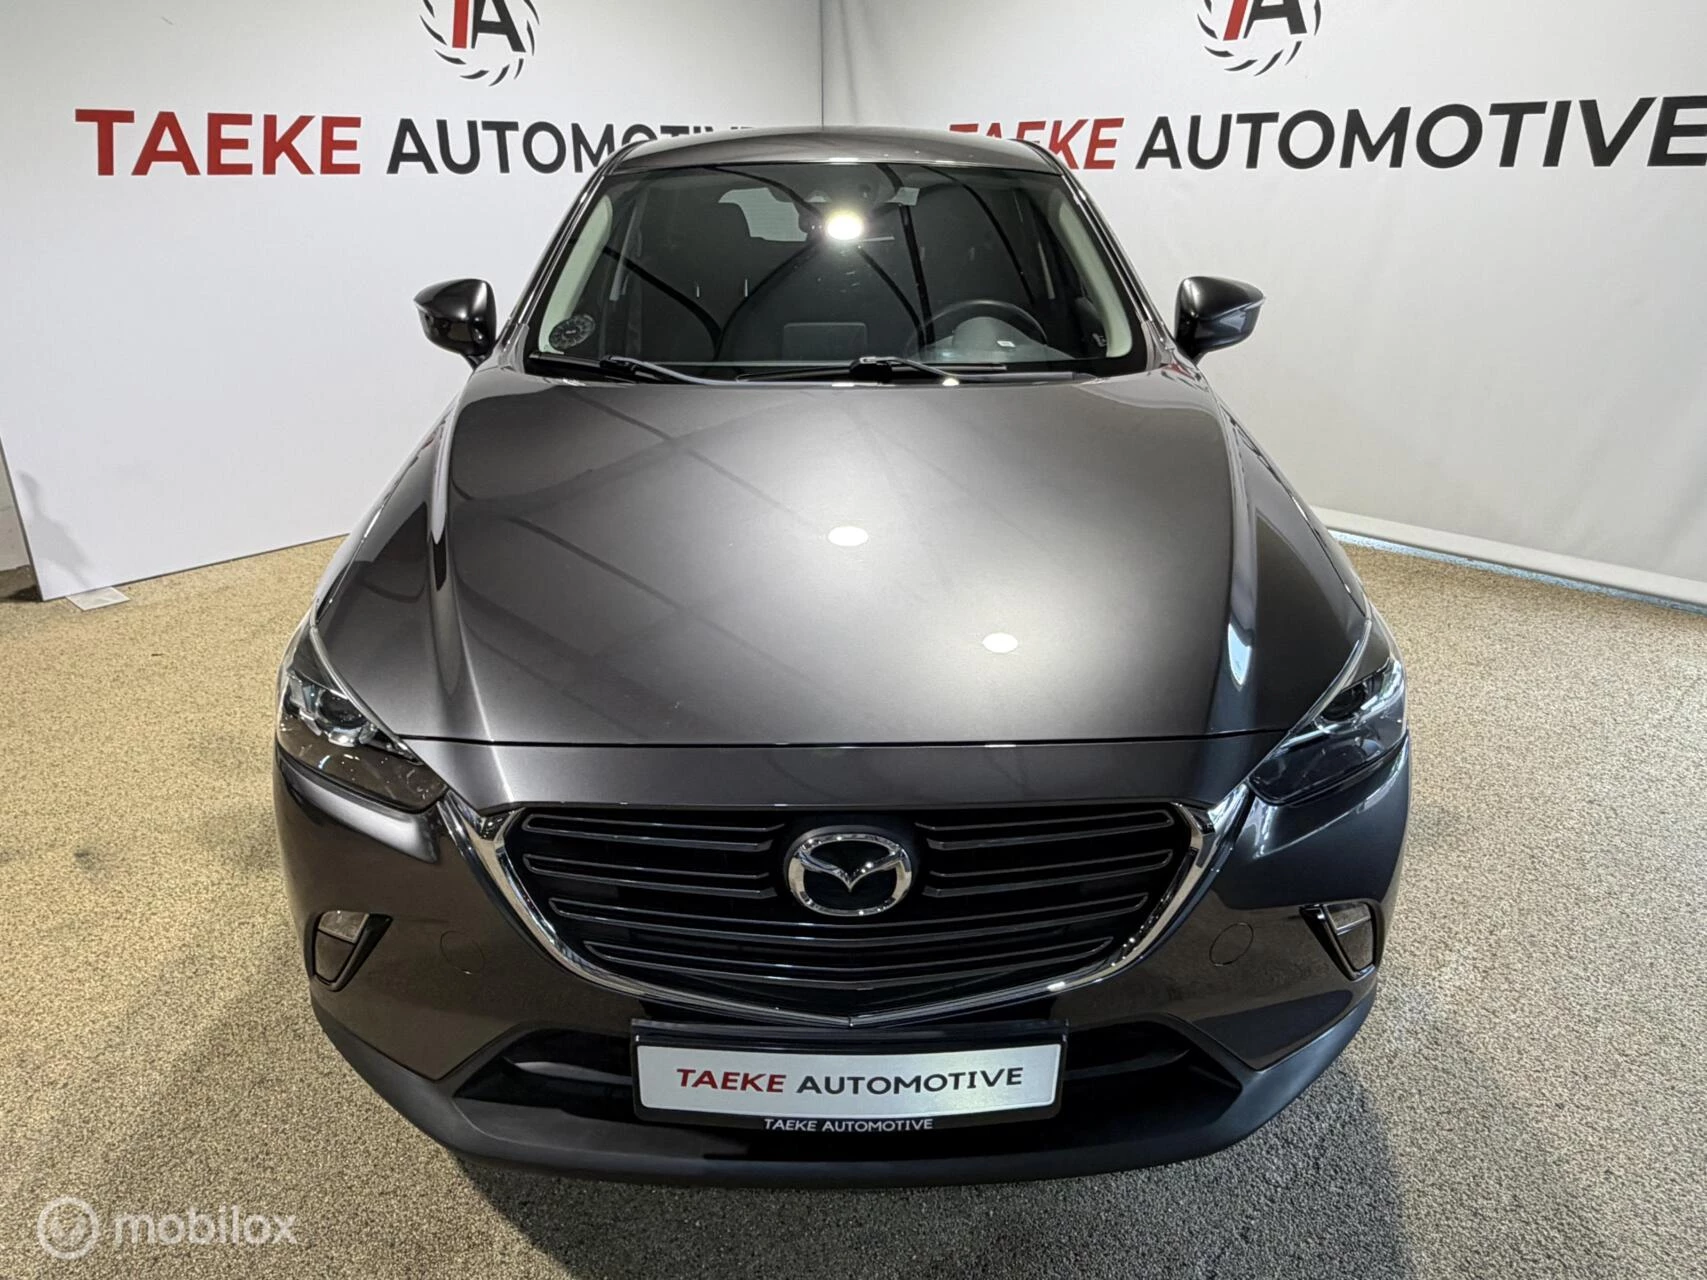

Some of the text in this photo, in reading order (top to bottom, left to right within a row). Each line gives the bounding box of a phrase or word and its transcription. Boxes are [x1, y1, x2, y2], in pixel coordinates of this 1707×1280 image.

[75, 109, 753, 176] TAEKE AUTOM
[1136, 95, 1707, 169] AUTOMOTIVE
[676, 1066, 1025, 1096] TAEKE AUTOMOTIVE
[763, 1118, 934, 1132] TAEKE AUTOMOTIVE
